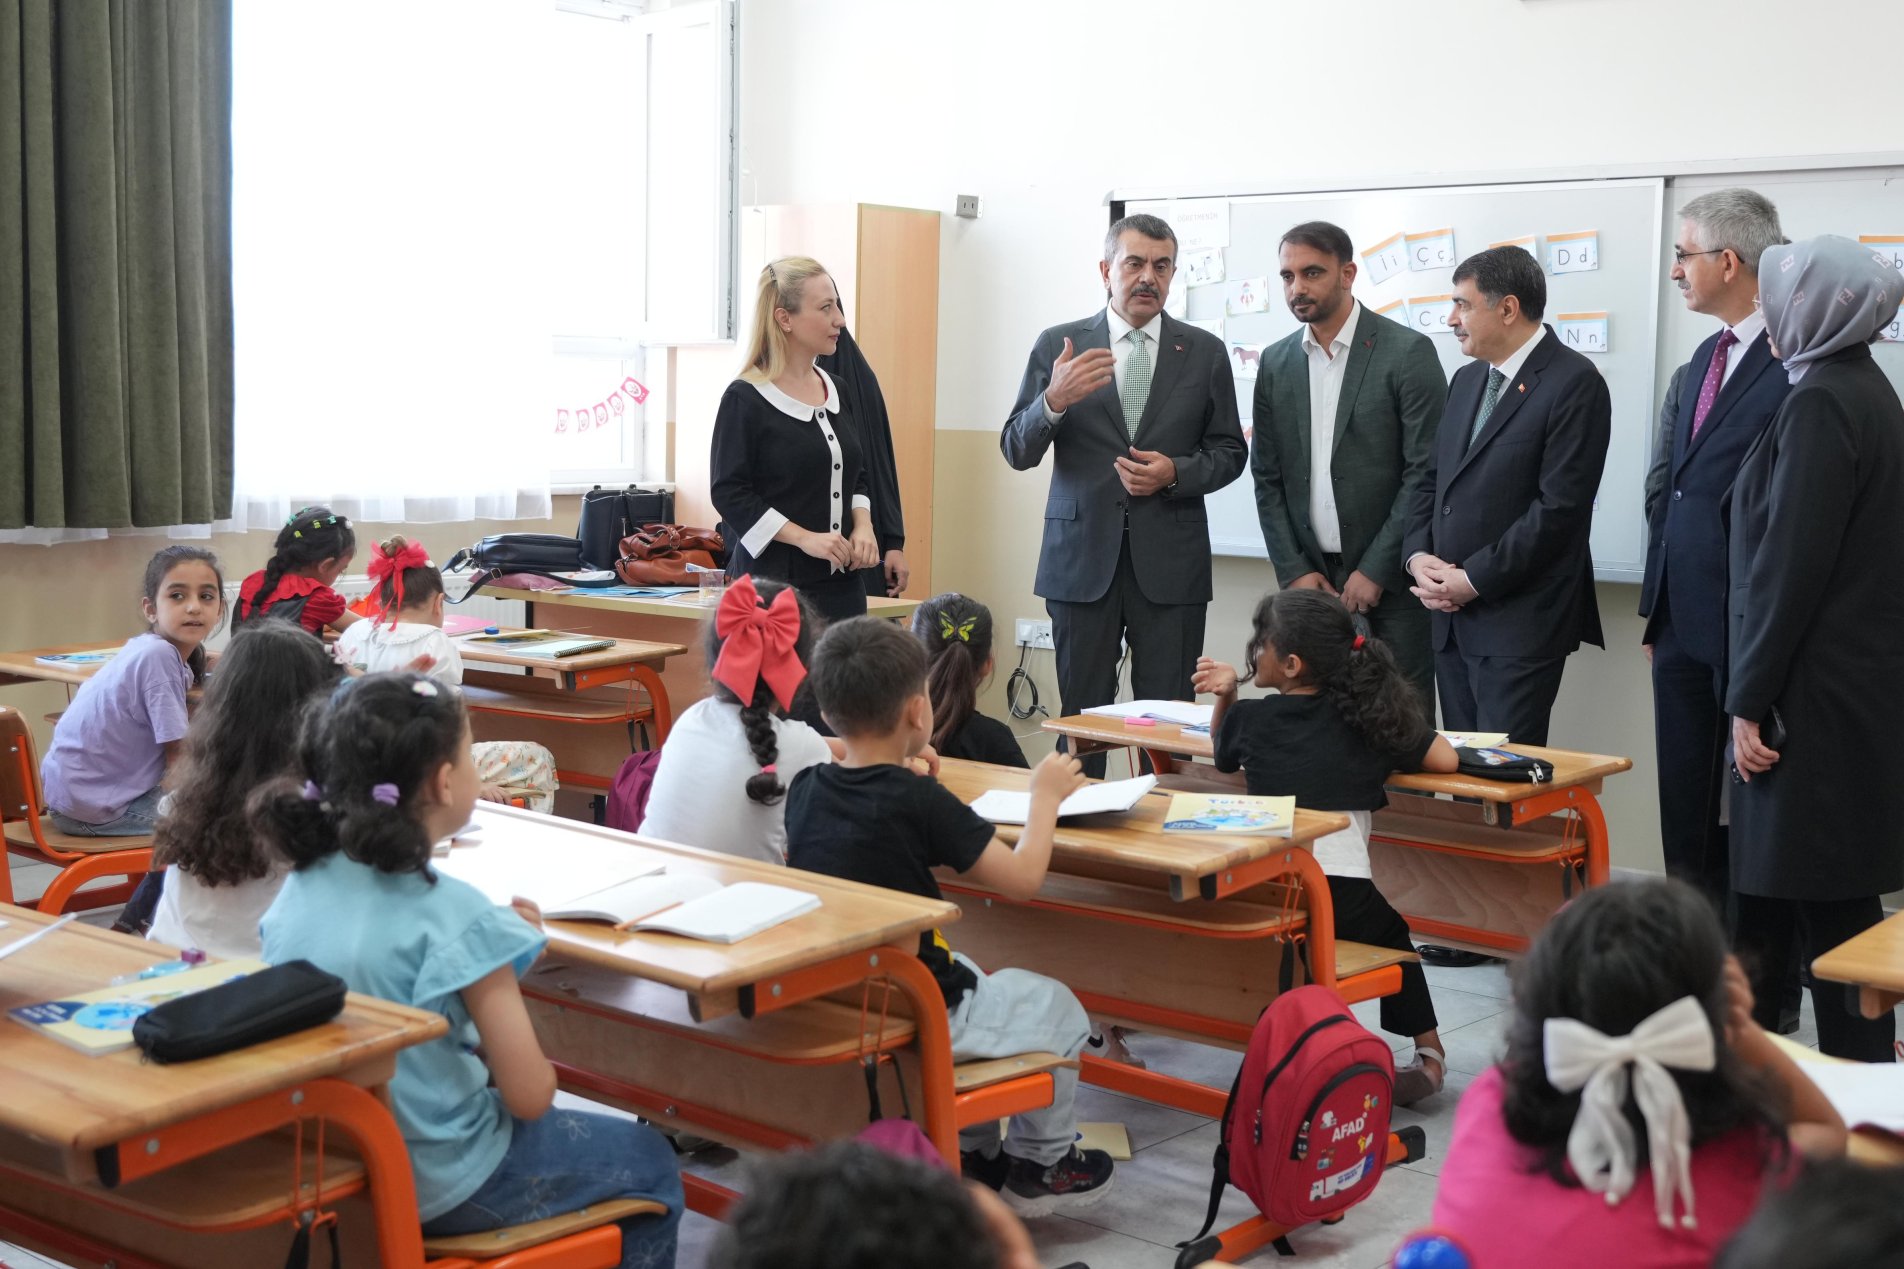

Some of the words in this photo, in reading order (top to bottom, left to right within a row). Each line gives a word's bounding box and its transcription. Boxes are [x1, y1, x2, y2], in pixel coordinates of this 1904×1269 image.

[1416, 246, 1429, 266] Ç
[1558, 249, 1571, 265] D
[1579, 247, 1587, 263] d
[1894, 252, 1903, 269] b
[1419, 310, 1431, 327] C
[1567, 328, 1580, 344] N
[1589, 333, 1597, 344] n
[1331, 1117, 1365, 1143] AFAD
